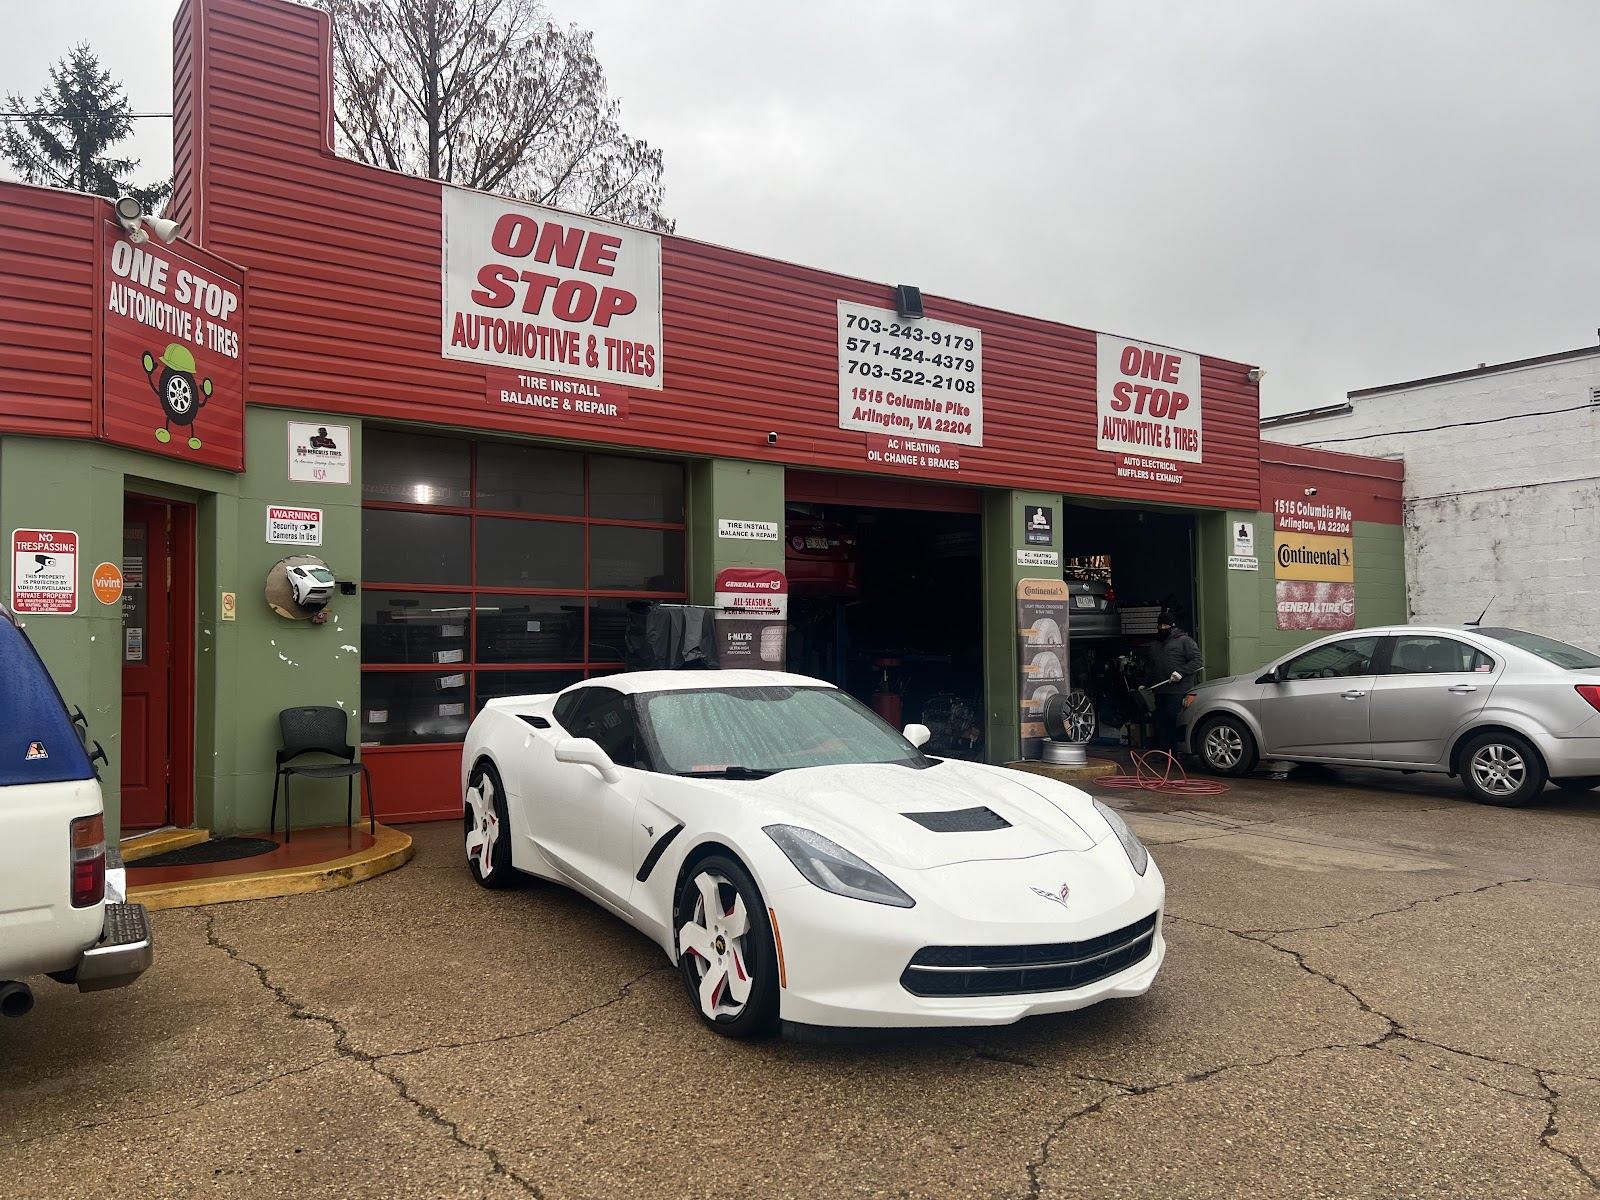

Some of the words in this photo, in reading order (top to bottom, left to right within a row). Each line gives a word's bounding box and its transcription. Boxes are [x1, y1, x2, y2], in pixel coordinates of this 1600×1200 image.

[491, 213, 622, 276] ONE
[111, 240, 170, 294] ONE
[175, 269, 238, 321] STOP
[471, 264, 637, 328] STOP
[109, 281, 191, 342] AUTOMOTIVE
[195, 316, 204, 345] &
[206, 321, 239, 359] TIRES
[846, 314, 974, 351] 703-243-9179
[451, 312, 580, 366] AUTOMOTIVE
[585, 334, 599, 368] &
[604, 337, 655, 378] TIRES
[846, 337, 975, 373] 571-424-4379
[1120, 345, 1182, 384] ONE
[518, 375, 547, 391] TIRE
[550, 380, 601, 398] INSTALL
[848, 360, 975, 394] 703-522-2108
[500, 390, 559, 410] BALANCE
[563, 399, 571, 410] &
[575, 400, 617, 416] REPAIR
[851, 387, 883, 404] 1515
[886, 392, 943, 413] Columbia
[945, 401, 970, 417] Pike
[1111, 382, 1189, 420] STOP
[852, 406, 914, 430] Arlington,
[917, 415, 932, 430] VA
[935, 419, 972, 436] 22204
[1102, 416, 1162, 447] AUTOMOTIVE
[1164, 425, 1171, 448] &
[1173, 426, 1198, 452] TIRES
[308, 448, 329, 456] HERCULES
[888, 439, 899, 449] AC
[905, 442, 940, 454] HEATING
[868, 451, 882, 461] OIL
[884, 452, 918, 465] CHANGE
[920, 457, 926, 465] &
[928, 457, 959, 470] BRAKES
[1124, 457, 1141, 466] AUTO
[1142, 458, 1177, 471] ELECTRICAL
[313, 469, 326, 480] USA
[1118, 468, 1148, 479] MUFFLERS
[1150, 471, 1154, 480] &
[1156, 473, 1183, 483] EXHAUST
[272, 510, 318, 520] WARNING
[1275, 500, 1295, 514] 1515
[1297, 502, 1333, 518] Columbia
[1336, 507, 1352, 520] Pike
[273, 522, 298, 531] Security
[744, 523, 770, 531] INSTALL
[1280, 517, 1315, 532] Arlington,
[1317, 521, 1326, 531] VA
[1328, 522, 1349, 533] 22204
[39, 533, 53, 541] NO
[272, 531, 297, 539] Cameras
[306, 533, 316, 541] Use
[16, 541, 75, 552] TRESPASSING
[1278, 544, 1340, 568] Continental
[95, 577, 121, 588] vivint
[1024, 586, 1059, 595] Continental
[734, 598, 766, 606] ALL-SEASON
[767, 599, 772, 607] &
[1278, 601, 1320, 612] GENERAL
[1320, 603, 1341, 613] TIRE
